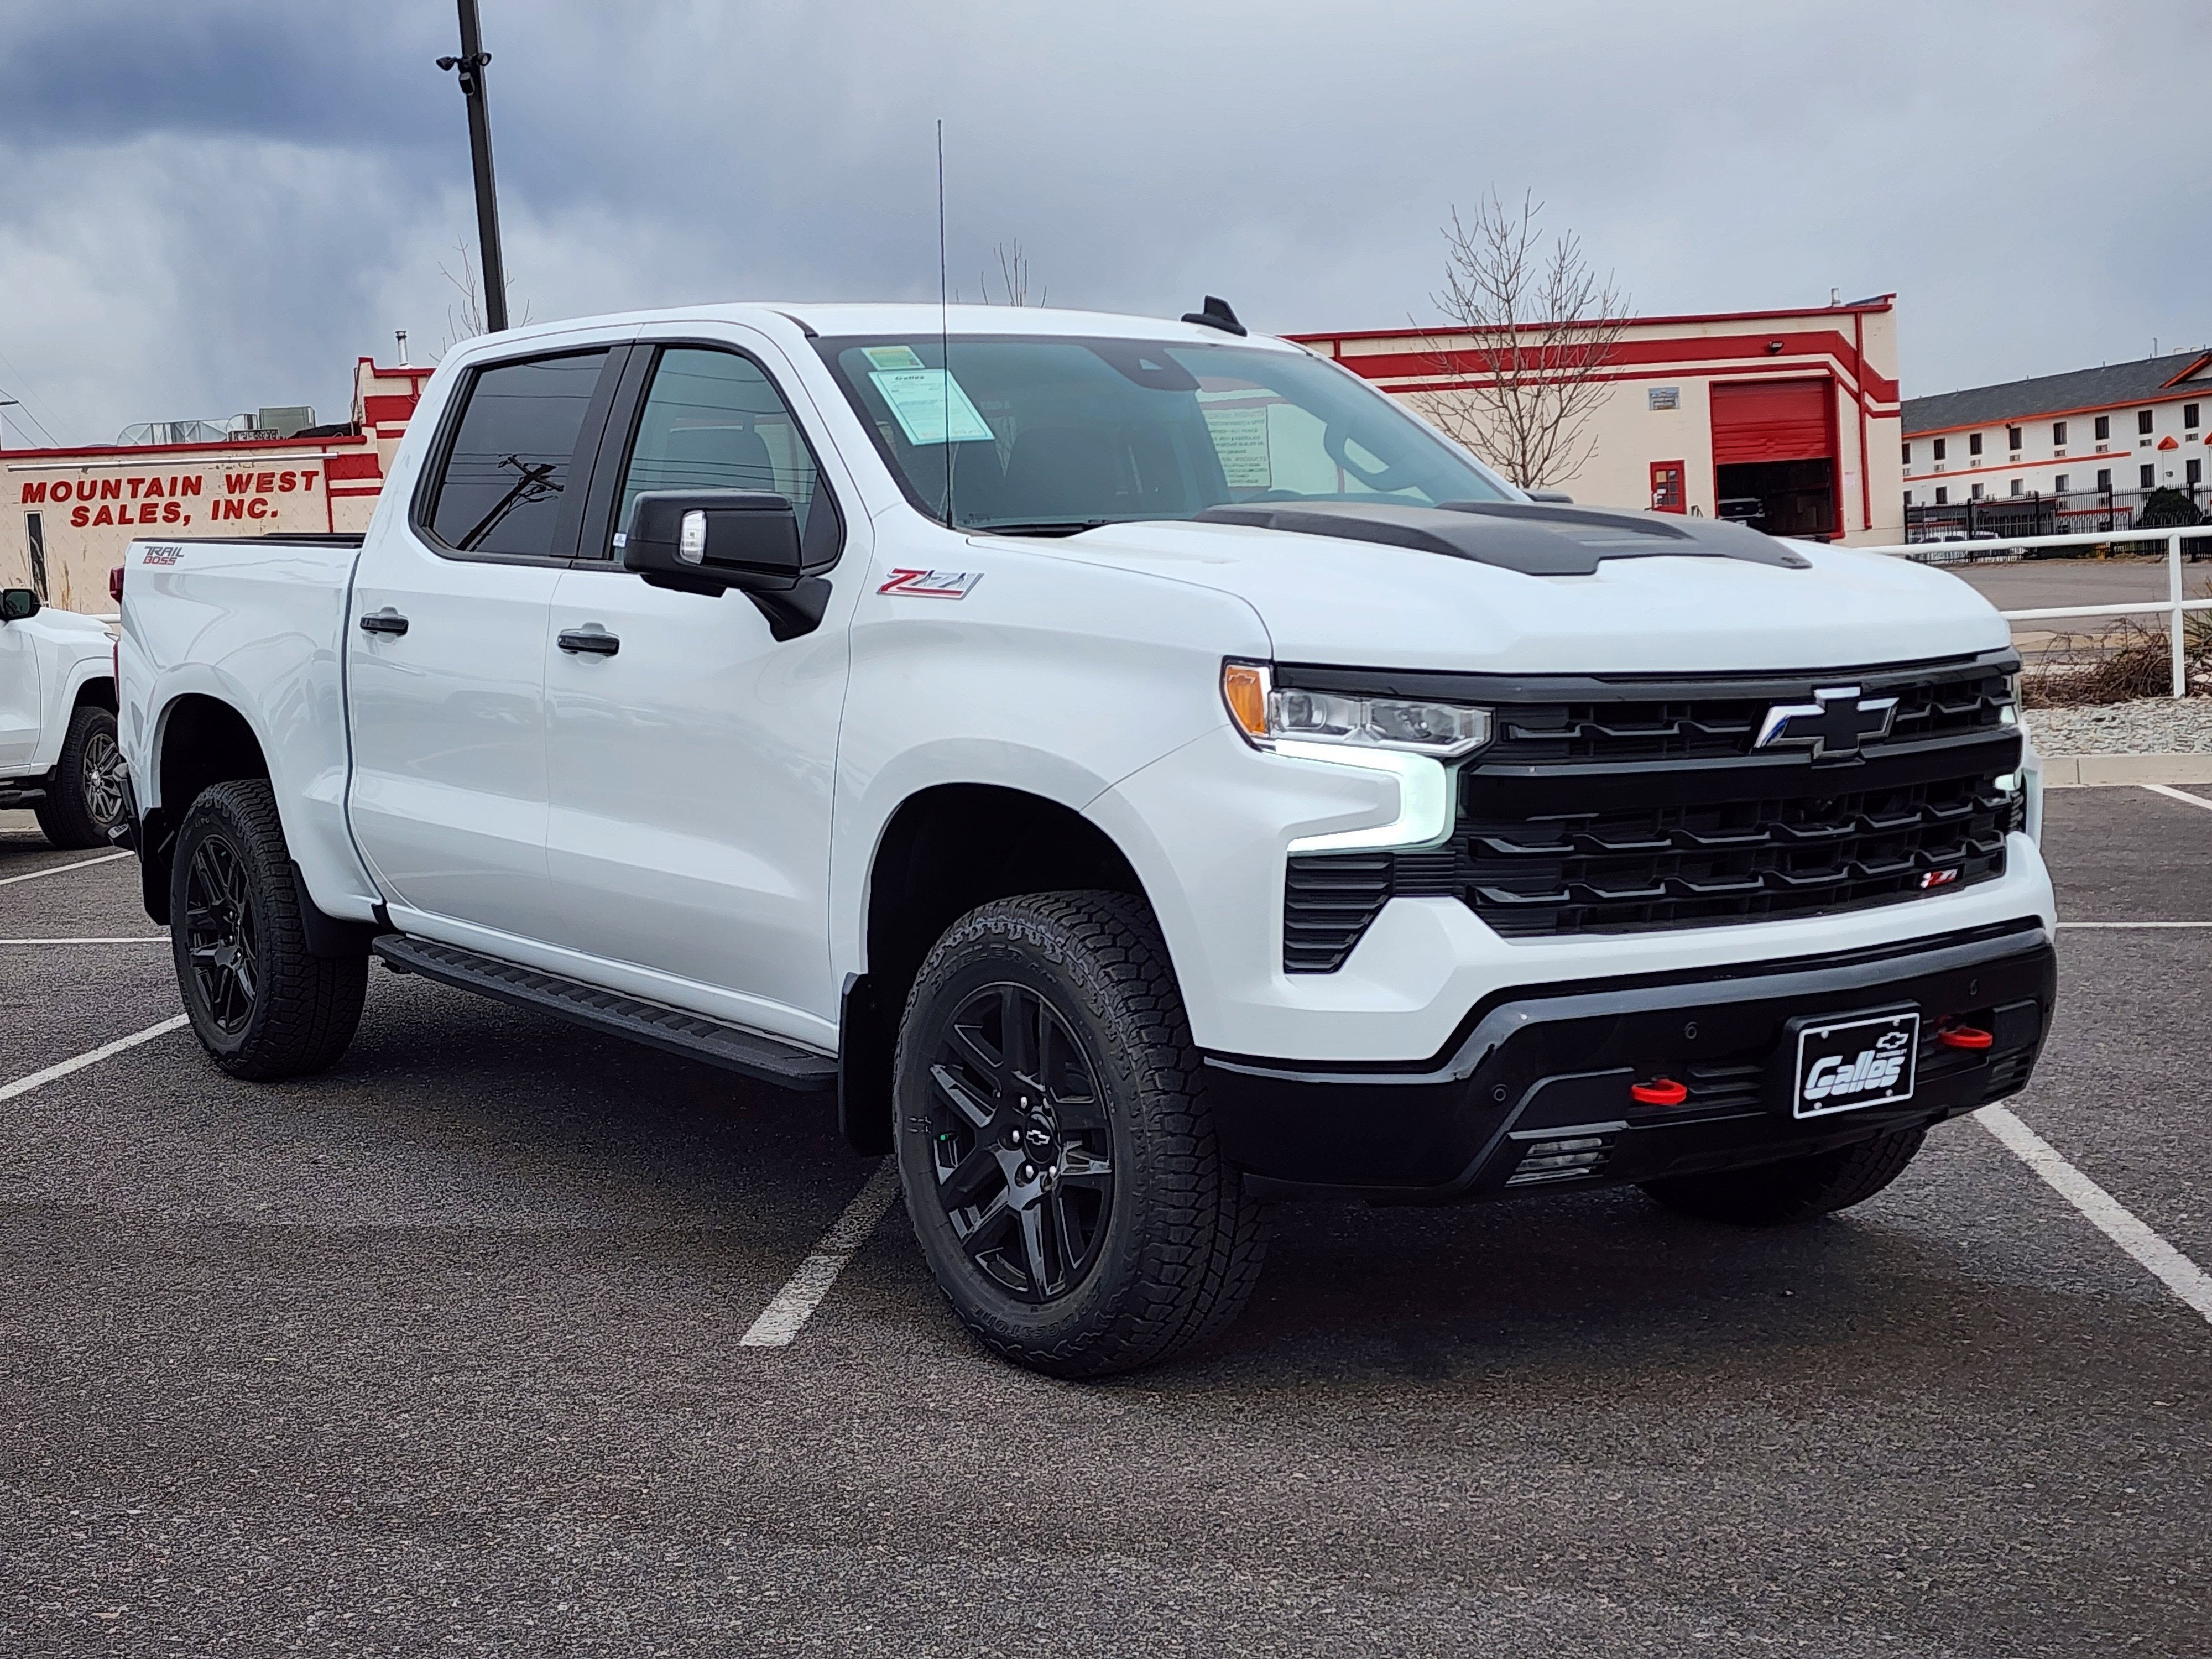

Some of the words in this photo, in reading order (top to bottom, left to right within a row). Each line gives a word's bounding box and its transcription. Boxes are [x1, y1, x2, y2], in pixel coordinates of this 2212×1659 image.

[21, 474, 202, 504] MOUNTAIN
[226, 470, 319, 494] WEST
[70, 501, 191, 527] SALES,
[211, 497, 278, 520] INC.
[142, 556, 178, 565] BOSS
[144, 546, 185, 558] TRAIL
[1803, 1049, 1906, 1100] Galles
